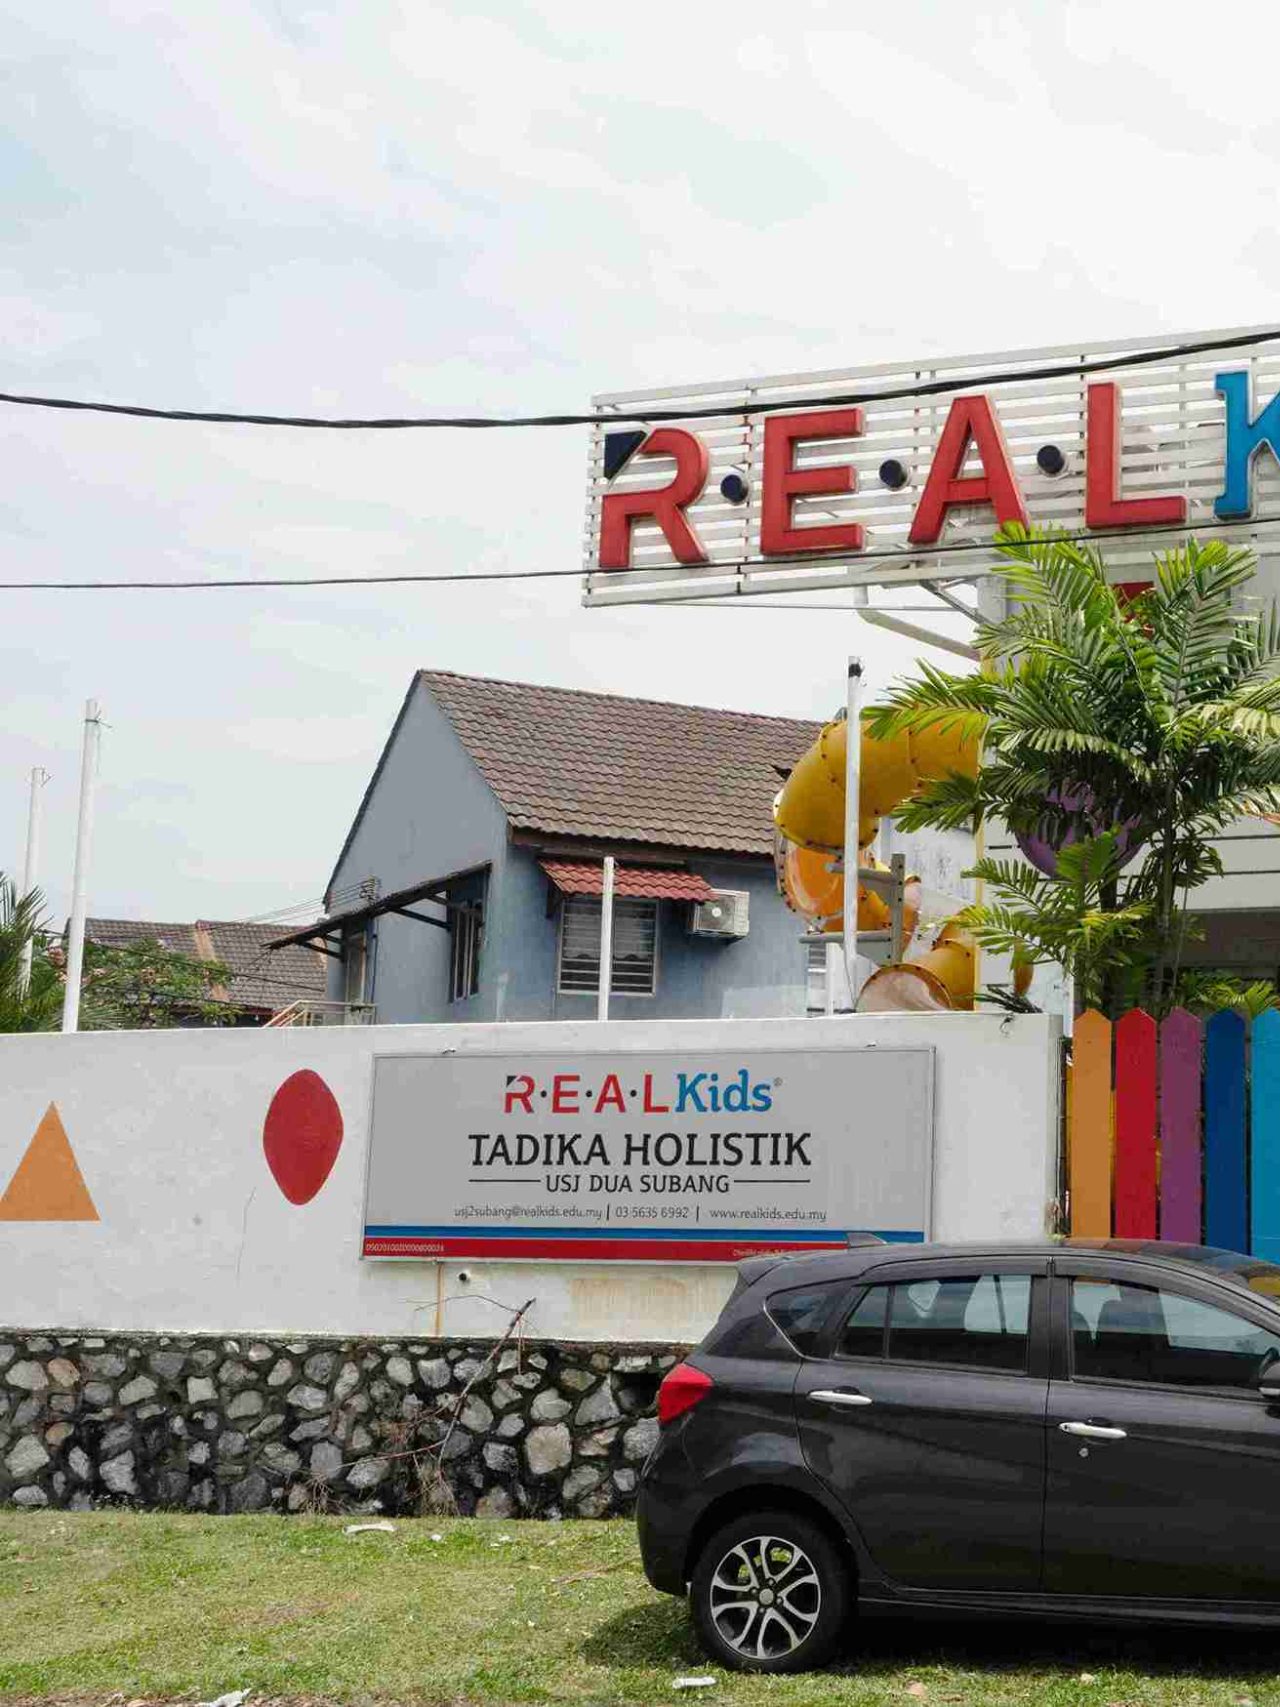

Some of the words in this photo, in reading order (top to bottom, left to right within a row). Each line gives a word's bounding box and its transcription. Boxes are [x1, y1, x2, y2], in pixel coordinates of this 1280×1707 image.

[468, 1133, 611, 1166] TADIKA
[623, 1132, 812, 1167] HOLISTIK
[545, 1174, 580, 1193] USJ
[589, 1174, 633, 1193] DUA
[639, 1174, 730, 1194] SUBANG
[454, 1204, 602, 1221] usj2subang@realkids.edu.my
[615, 1206, 630, 1218] 03
[632, 1206, 658, 1219] 5635
[709, 1205, 828, 1221] www.realkids.edu.my
